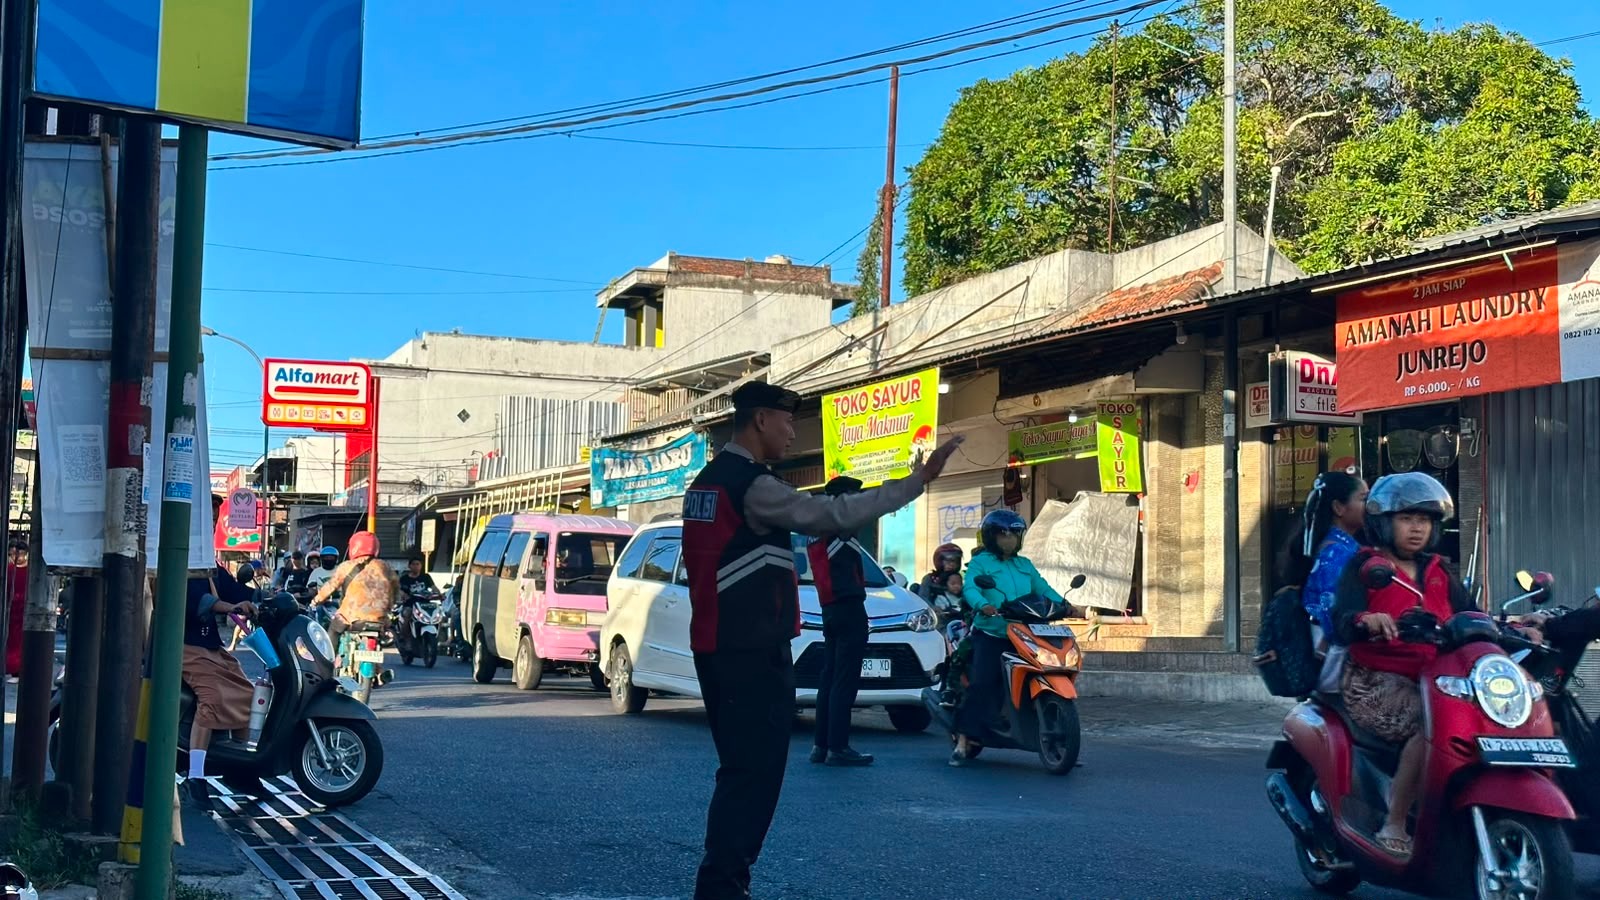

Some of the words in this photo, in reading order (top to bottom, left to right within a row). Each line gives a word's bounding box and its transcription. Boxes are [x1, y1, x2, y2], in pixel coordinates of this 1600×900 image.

[1413, 287, 1420, 298] 2
[1420, 284, 1441, 299] JAM
[1443, 277, 1466, 294] SIAP
[1344, 307, 1434, 347] AMANAH
[1440, 287, 1549, 329] LAUNDRY
[1564, 330, 1581, 339] 0822
[1583, 328, 1592, 337] 112
[1396, 338, 1488, 382] JUNREJO
[274, 367, 360, 385] Alfamart
[1404, 385, 1417, 397] RP
[1466, 376, 1481, 388] KG
[833, 390, 869, 418] TOKO
[872, 378, 921, 410] SAYUR
[1099, 403, 1136, 414] TOKO
[838, 421, 864, 450] Jaya
[866, 413, 914, 439] Makmur
[1022, 431, 1041, 447] Toko
[1041, 427, 1065, 446] Sayur
[1067, 423, 1089, 443] Jaya
[648, 441, 692, 473] BARU
[1112, 416, 1126, 488] SAYUR
[879, 659, 890, 671] XD
